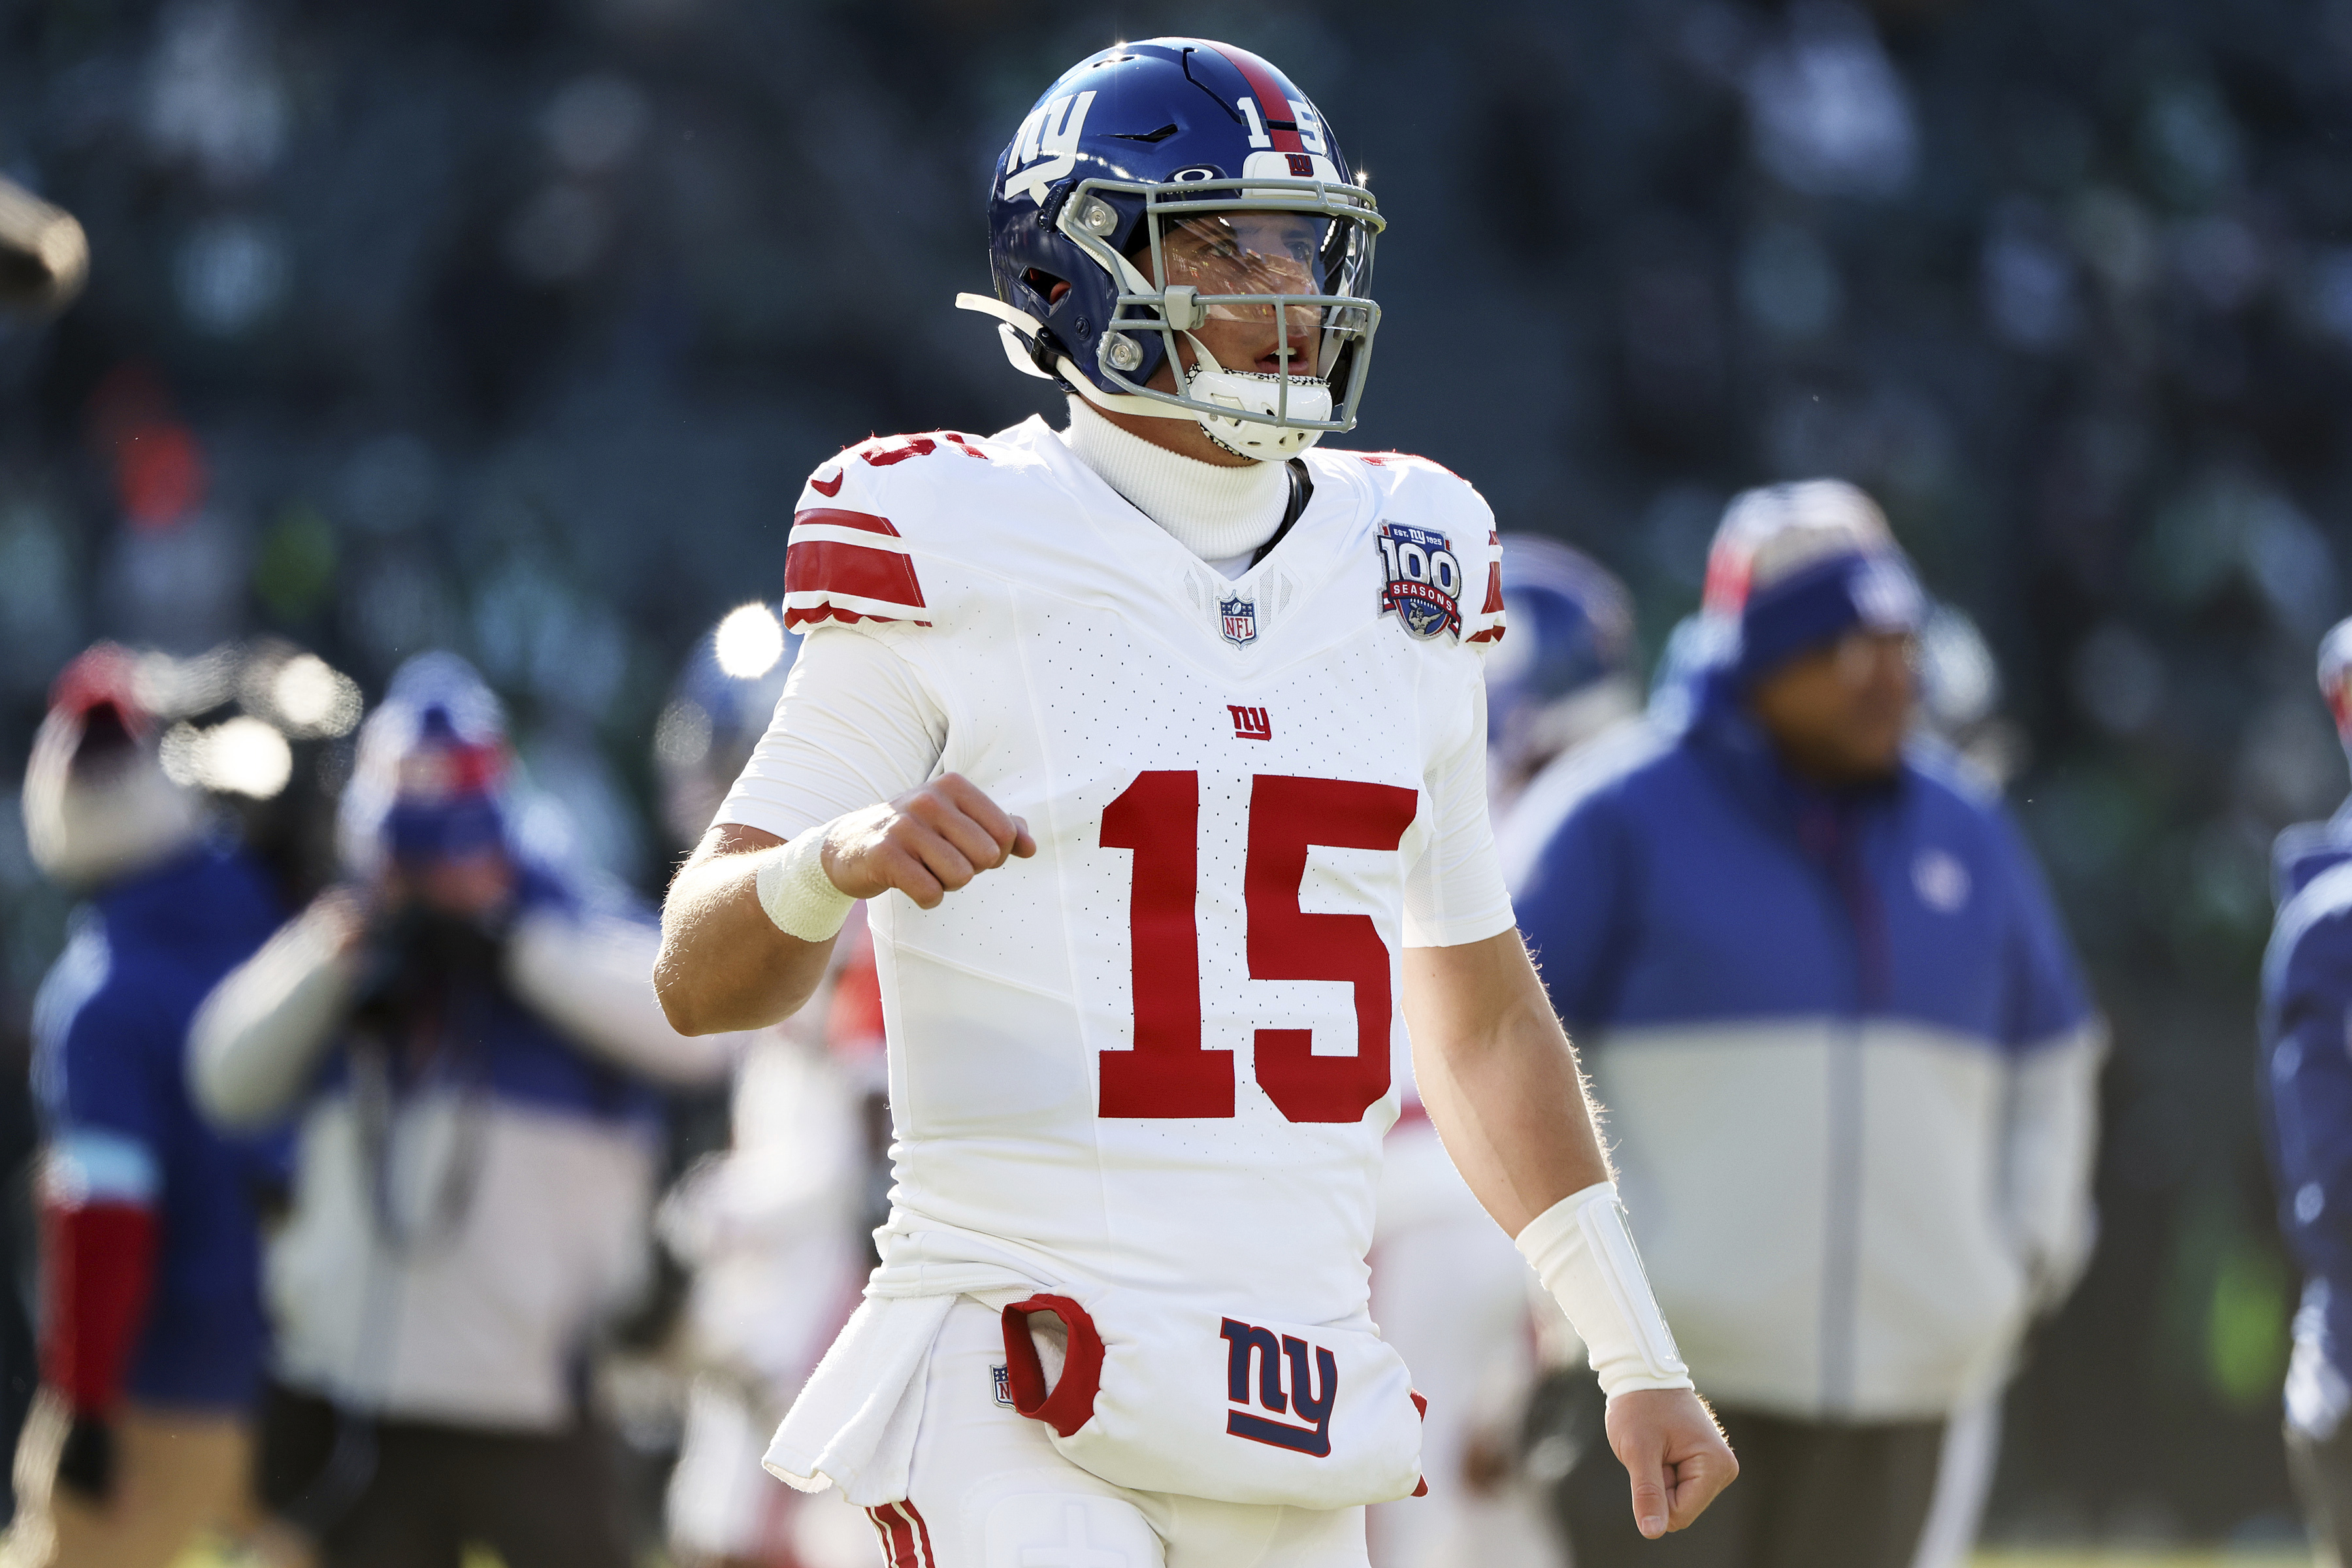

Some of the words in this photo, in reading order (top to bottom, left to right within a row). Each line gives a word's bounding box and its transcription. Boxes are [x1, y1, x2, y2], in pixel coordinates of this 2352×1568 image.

[1236, 97, 1327, 156] 15
[1394, 528, 1408, 537] EST.
[1426, 536, 1442, 546] 1925
[1380, 538, 1461, 597] 100
[1394, 585, 1452, 611] SEASONS
[1225, 617, 1252, 638] NFL
[1226, 704, 1271, 741] ny
[1098, 770, 1418, 1123] 15
[1220, 1316, 1338, 1458] ny
